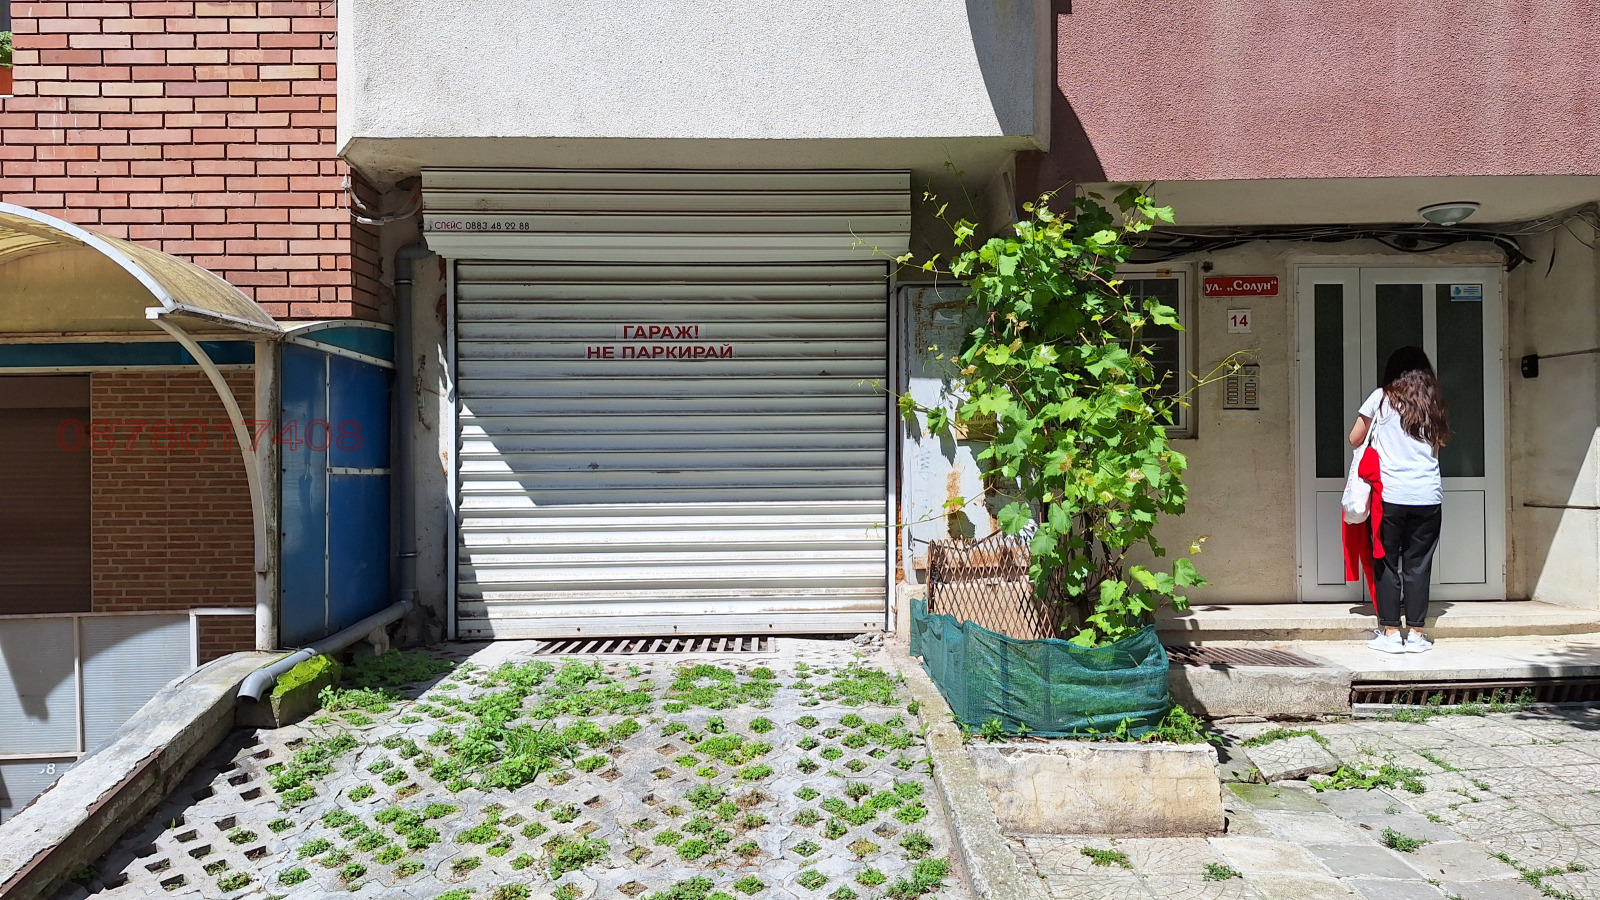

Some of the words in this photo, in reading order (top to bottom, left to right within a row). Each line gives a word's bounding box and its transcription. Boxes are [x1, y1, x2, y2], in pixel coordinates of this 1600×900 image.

[434, 220, 463, 230] СПЕЙС
[465, 221, 488, 230] 0883
[491, 221, 502, 230] 48
[504, 221, 516, 230] 22
[519, 221, 530, 230] 88
[1205, 283, 1223, 294] ул.
[1230, 314, 1249, 327] 14
[623, 325, 699, 340] ГАРАЖ!
[587, 346, 615, 359] НЕ
[622, 343, 733, 359] ПАРКИРАЙ
